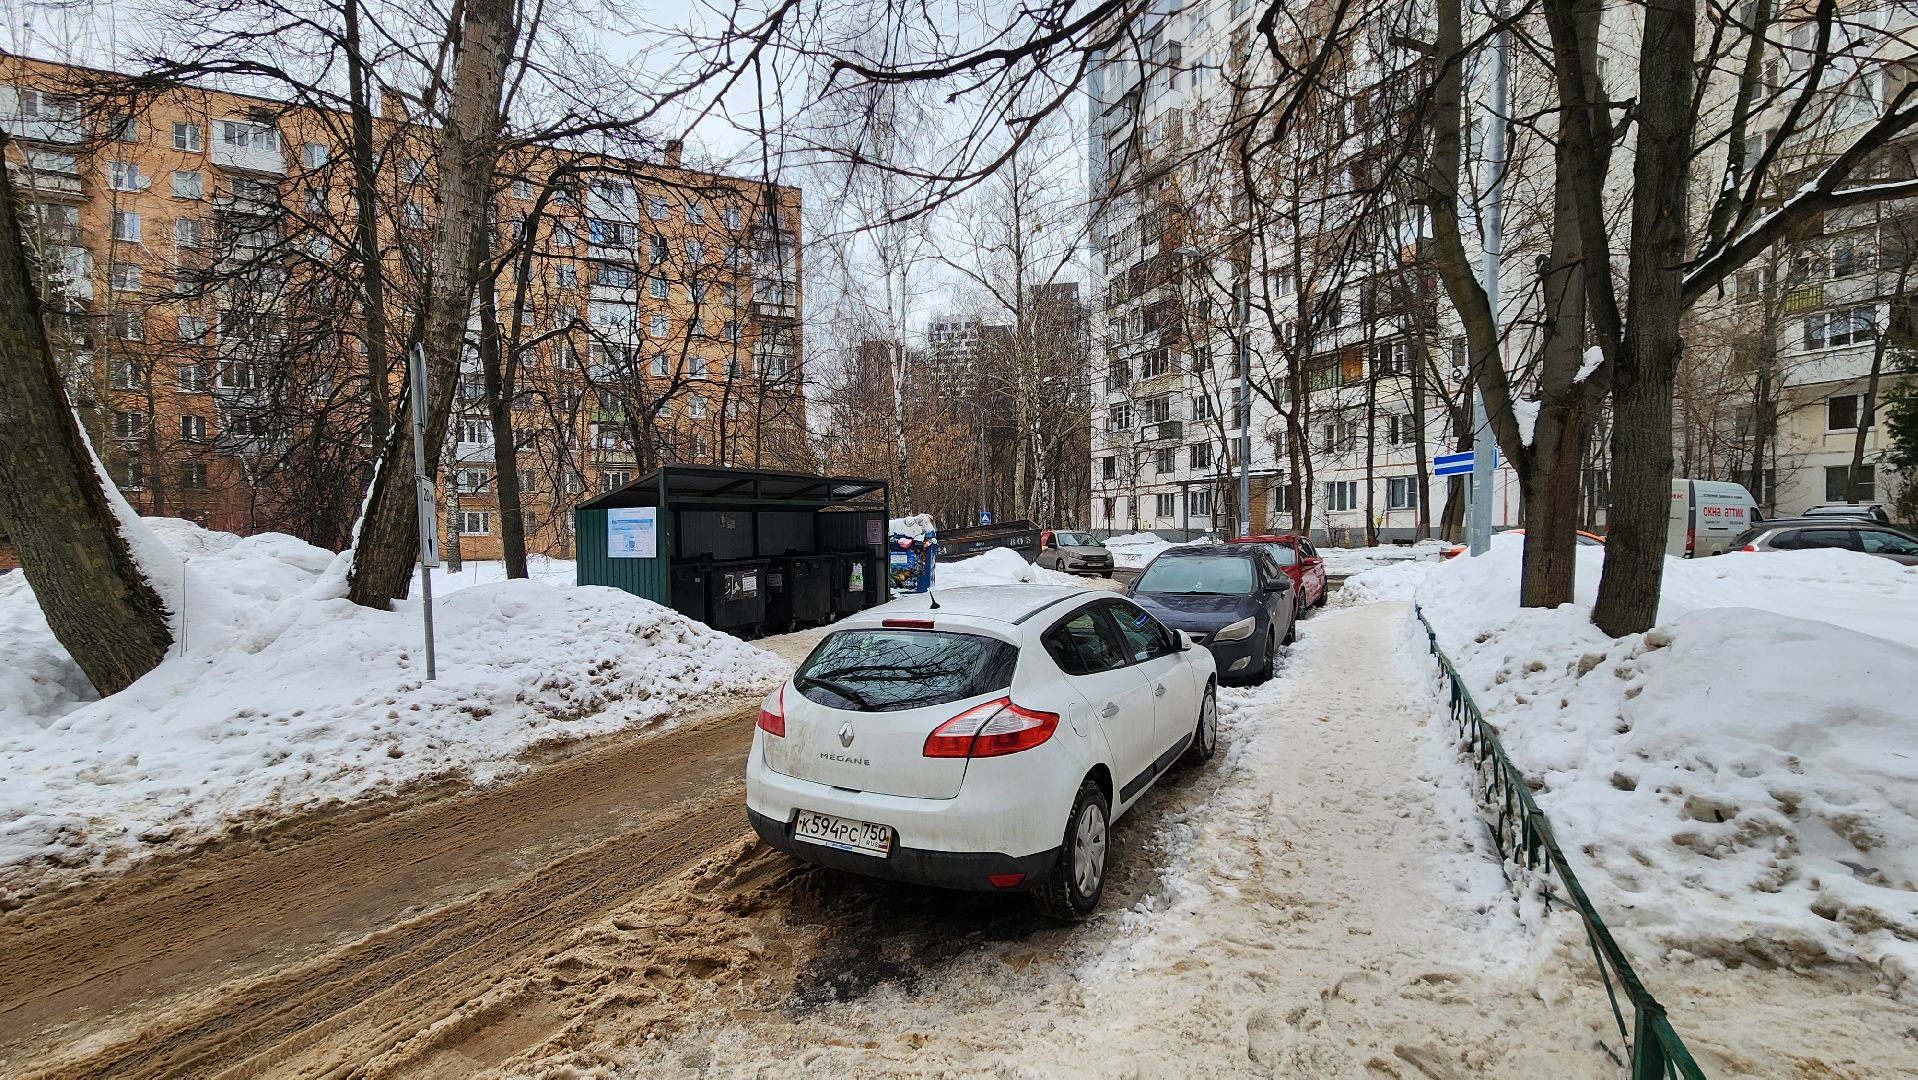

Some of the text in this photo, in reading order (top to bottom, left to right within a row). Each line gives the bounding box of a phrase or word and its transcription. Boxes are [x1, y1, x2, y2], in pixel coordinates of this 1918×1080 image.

[820, 752, 871, 766] MEGANE
[801, 815, 887, 843] К594РС 750
[865, 839, 879, 848] RUS
